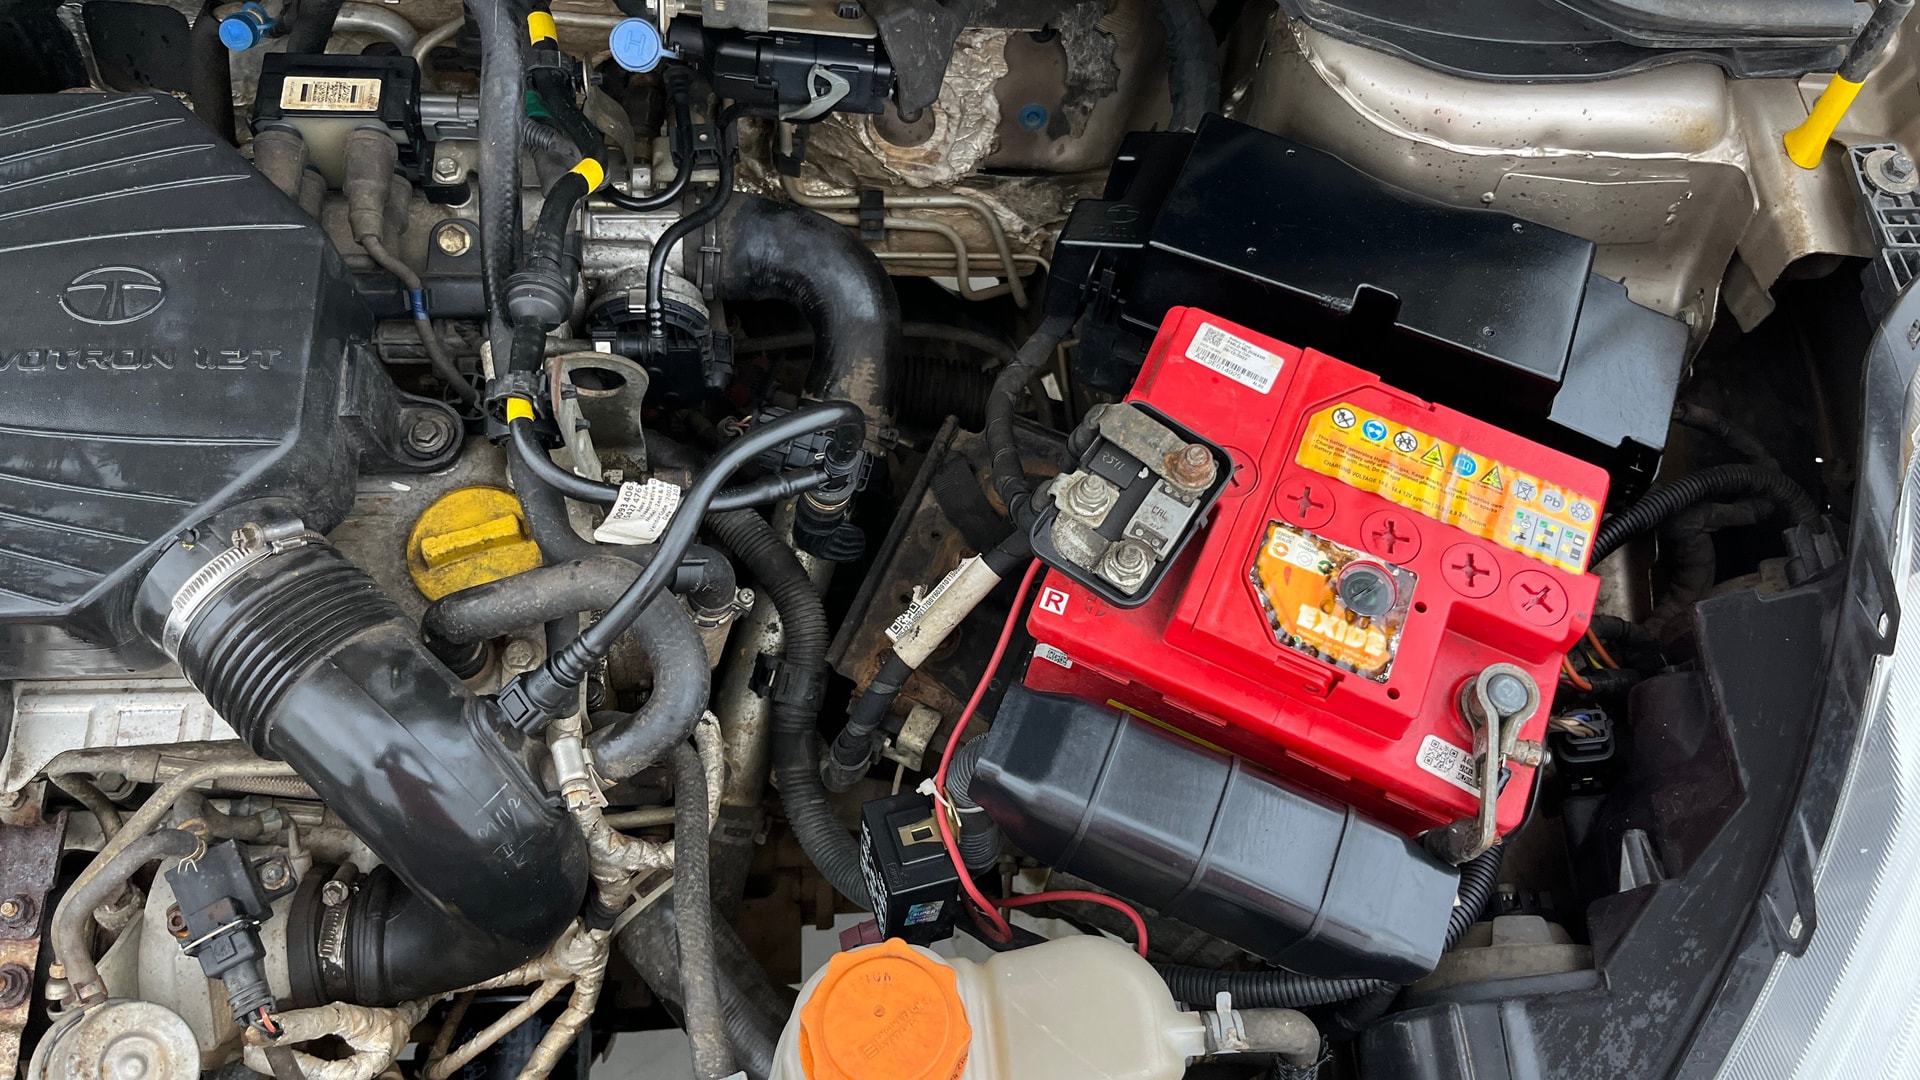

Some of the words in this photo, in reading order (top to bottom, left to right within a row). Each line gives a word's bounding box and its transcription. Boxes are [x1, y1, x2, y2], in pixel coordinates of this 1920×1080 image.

[625, 30, 646, 55] H
[1322, 459, 1351, 474] CHARGING
[1351, 470, 1376, 483] VOLTAGE
[624, 482, 634, 502] 406
[632, 484, 642, 503] 476
[1543, 494, 1561, 507] Pb
[1044, 591, 1065, 612] R
[1296, 604, 1386, 656] EXIDE
